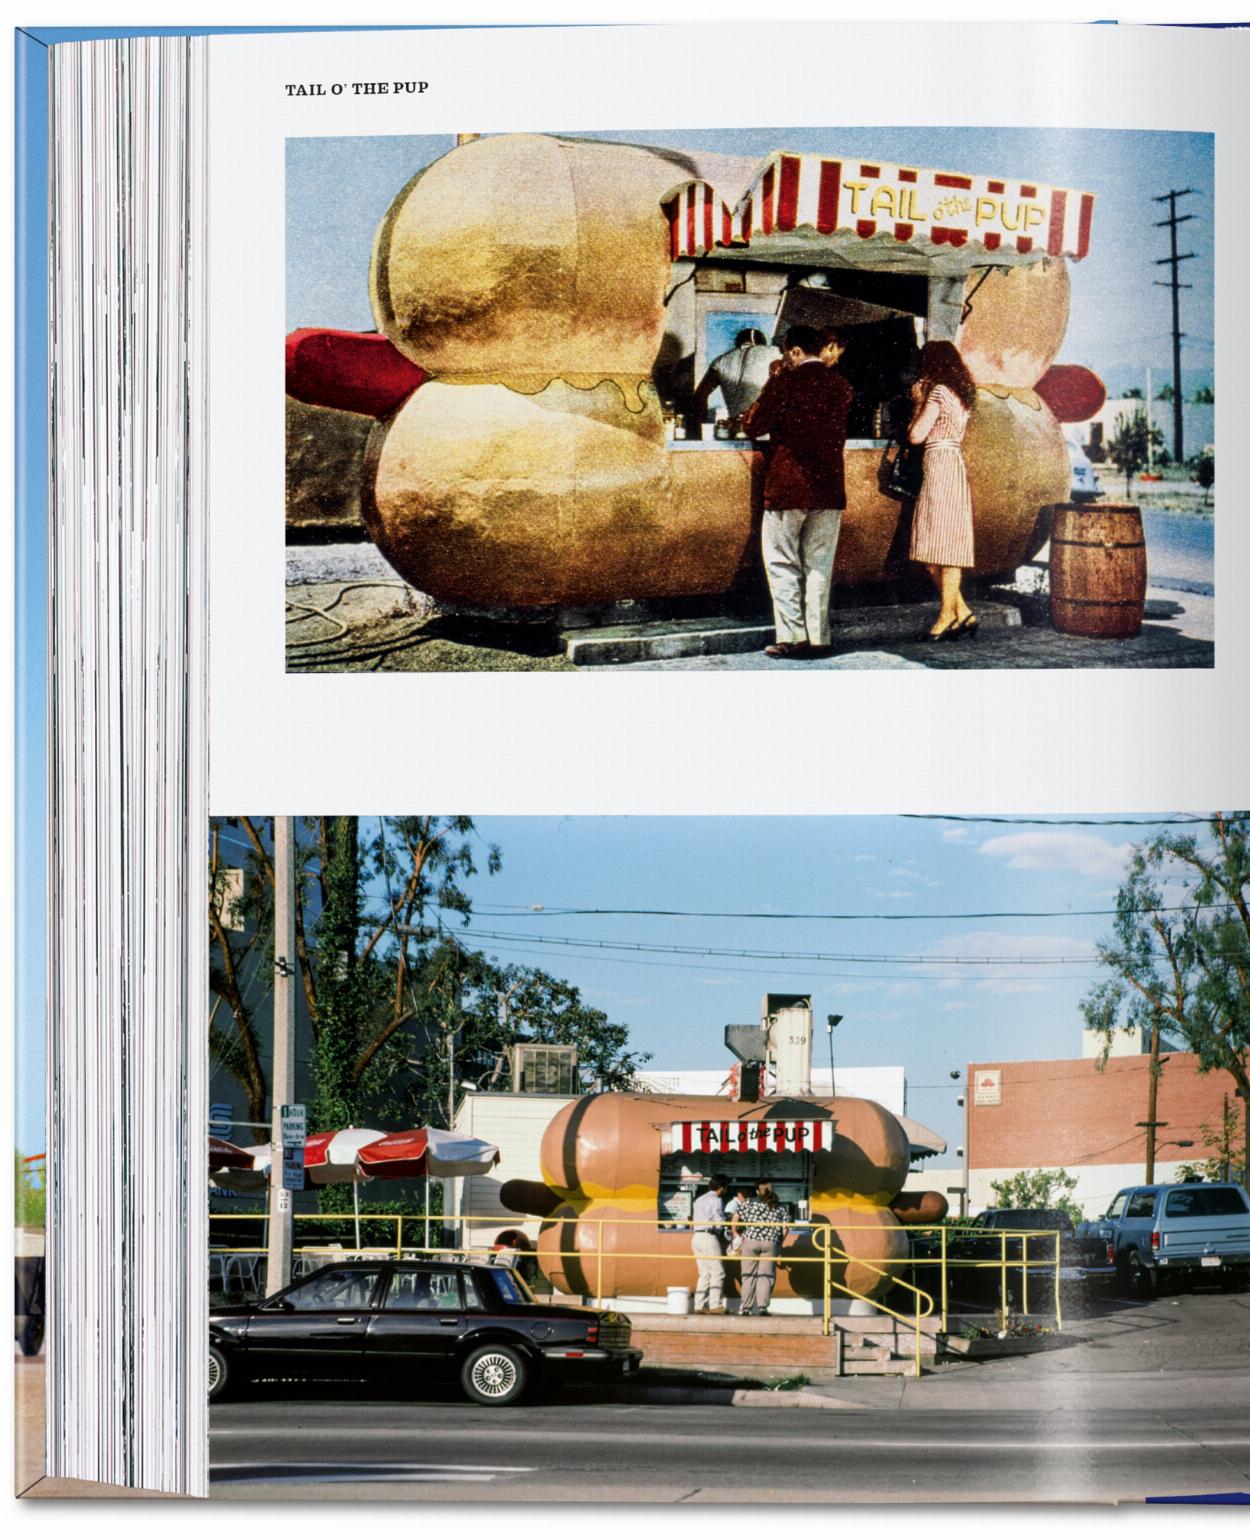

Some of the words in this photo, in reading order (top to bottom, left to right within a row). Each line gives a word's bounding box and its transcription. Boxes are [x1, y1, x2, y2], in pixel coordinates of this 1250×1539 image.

[285, 83, 327, 96] TAIL
[352, 82, 389, 95] THE
[393, 81, 429, 94] PUP
[843, 181, 928, 222] TAIL
[975, 196, 1046, 232] PUP
[788, 1035, 807, 1046] 329
[696, 1127, 735, 1143] TAIL
[772, 1127, 810, 1143] PUP
